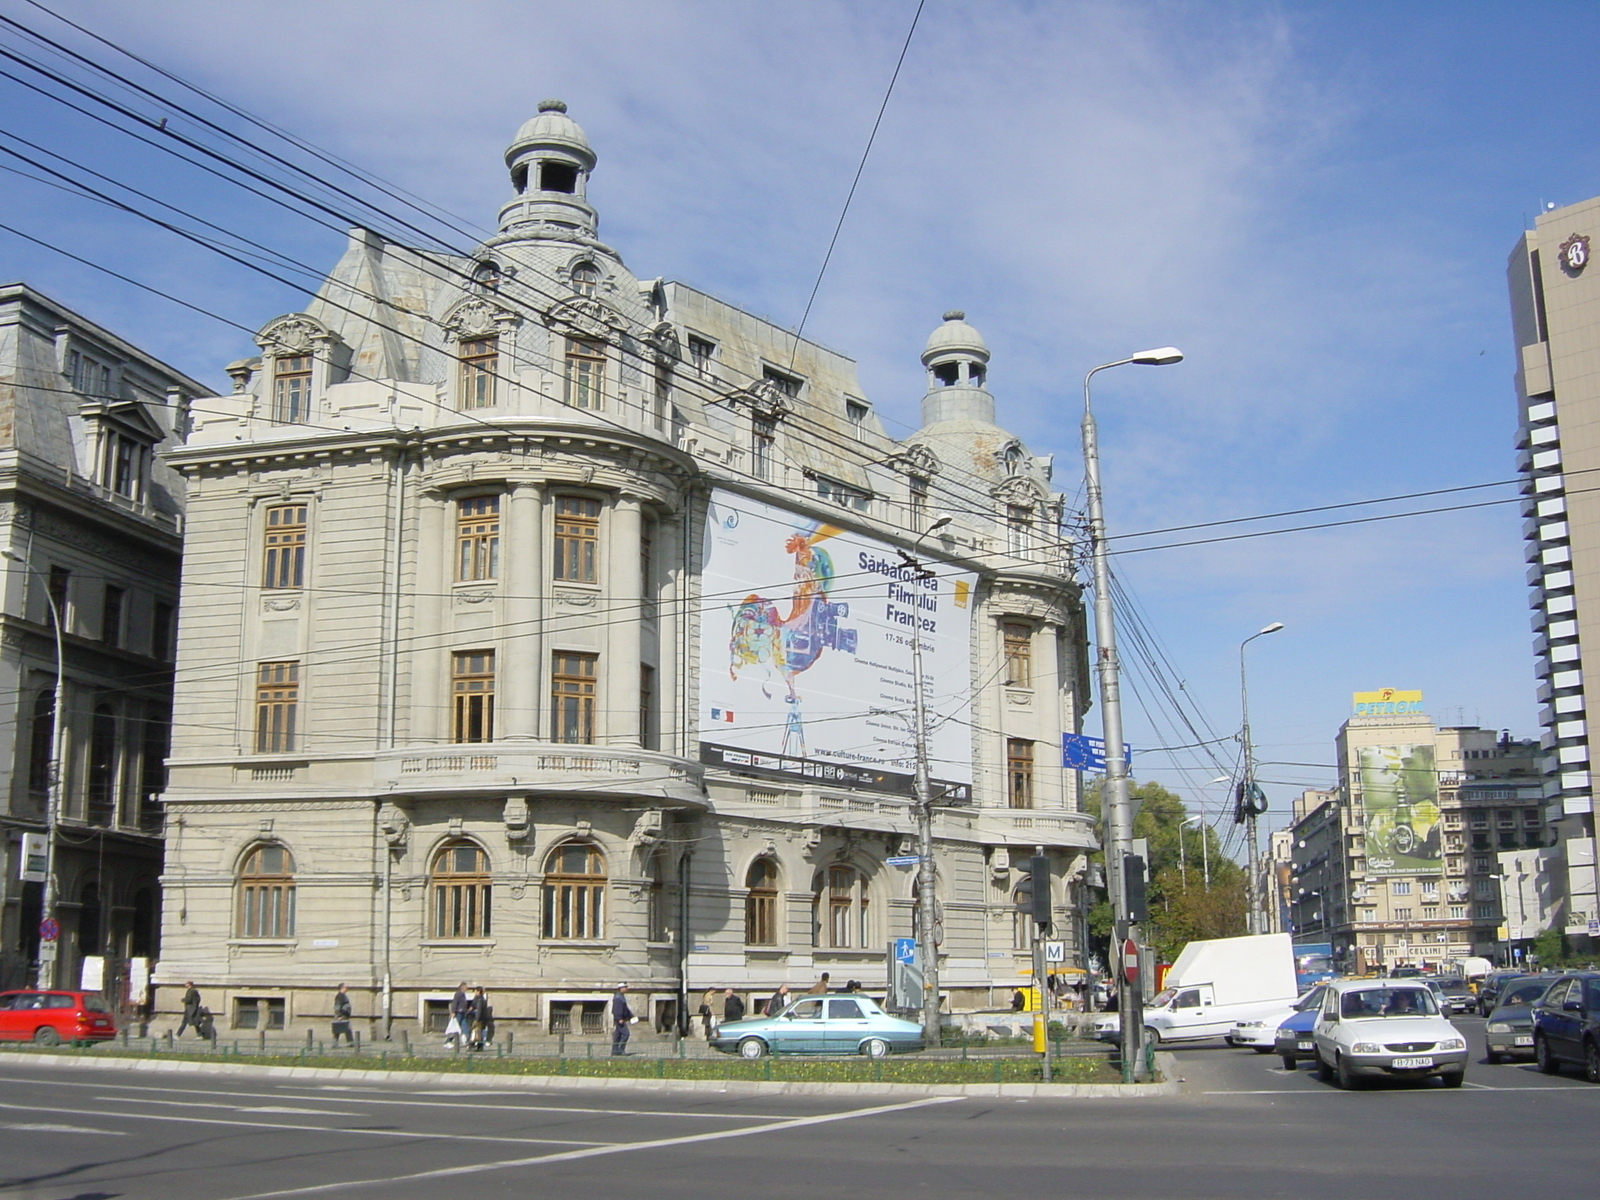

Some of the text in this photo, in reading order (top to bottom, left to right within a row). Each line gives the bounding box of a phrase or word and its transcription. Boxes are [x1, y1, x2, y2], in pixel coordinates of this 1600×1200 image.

[888, 583, 937, 612] Filmului
[886, 603, 936, 633] Francez
[1355, 701, 1424, 715] PETROM
[1048, 946, 1060, 959] M
[1365, 948, 1398, 956] CEINI
